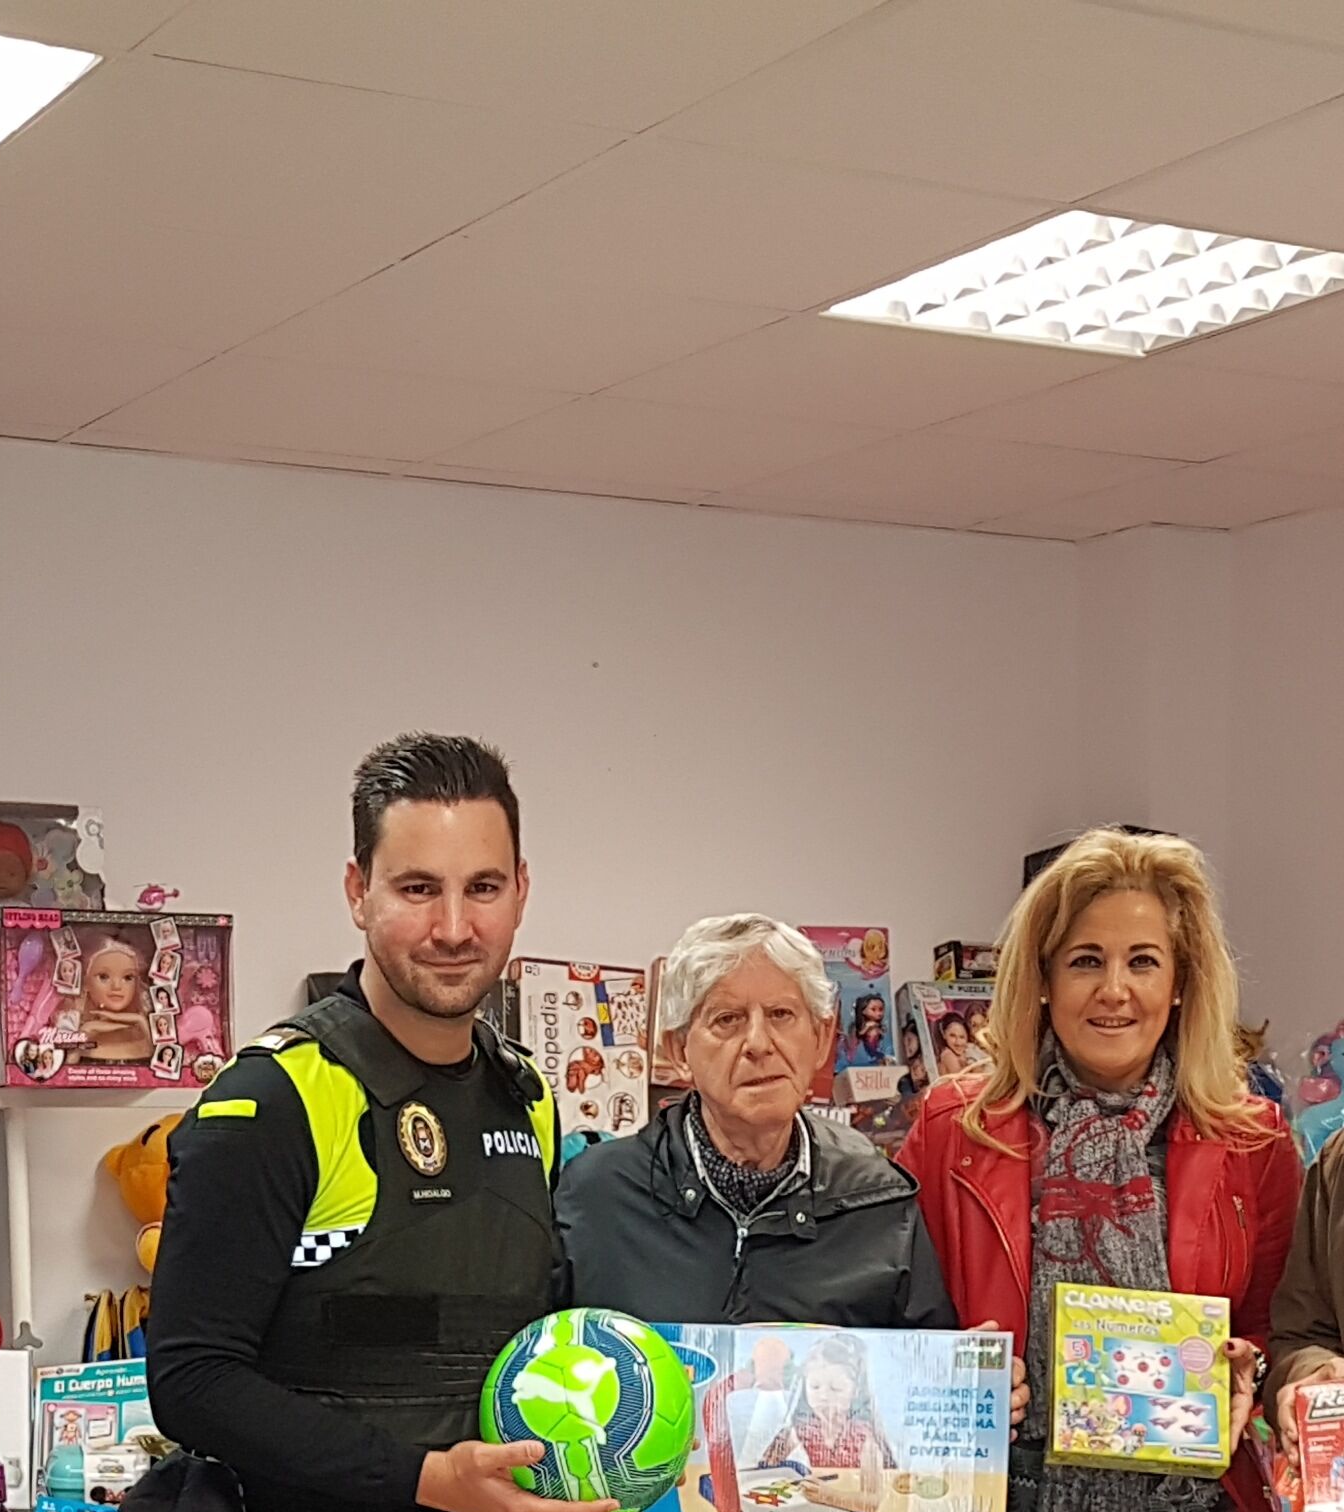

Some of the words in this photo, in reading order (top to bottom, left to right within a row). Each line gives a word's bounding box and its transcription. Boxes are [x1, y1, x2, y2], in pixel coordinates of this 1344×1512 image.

[856, 1070, 892, 1091] Stella
[68, 1379, 114, 1395] Cuerpo
[976, 1402, 994, 1414] DE
